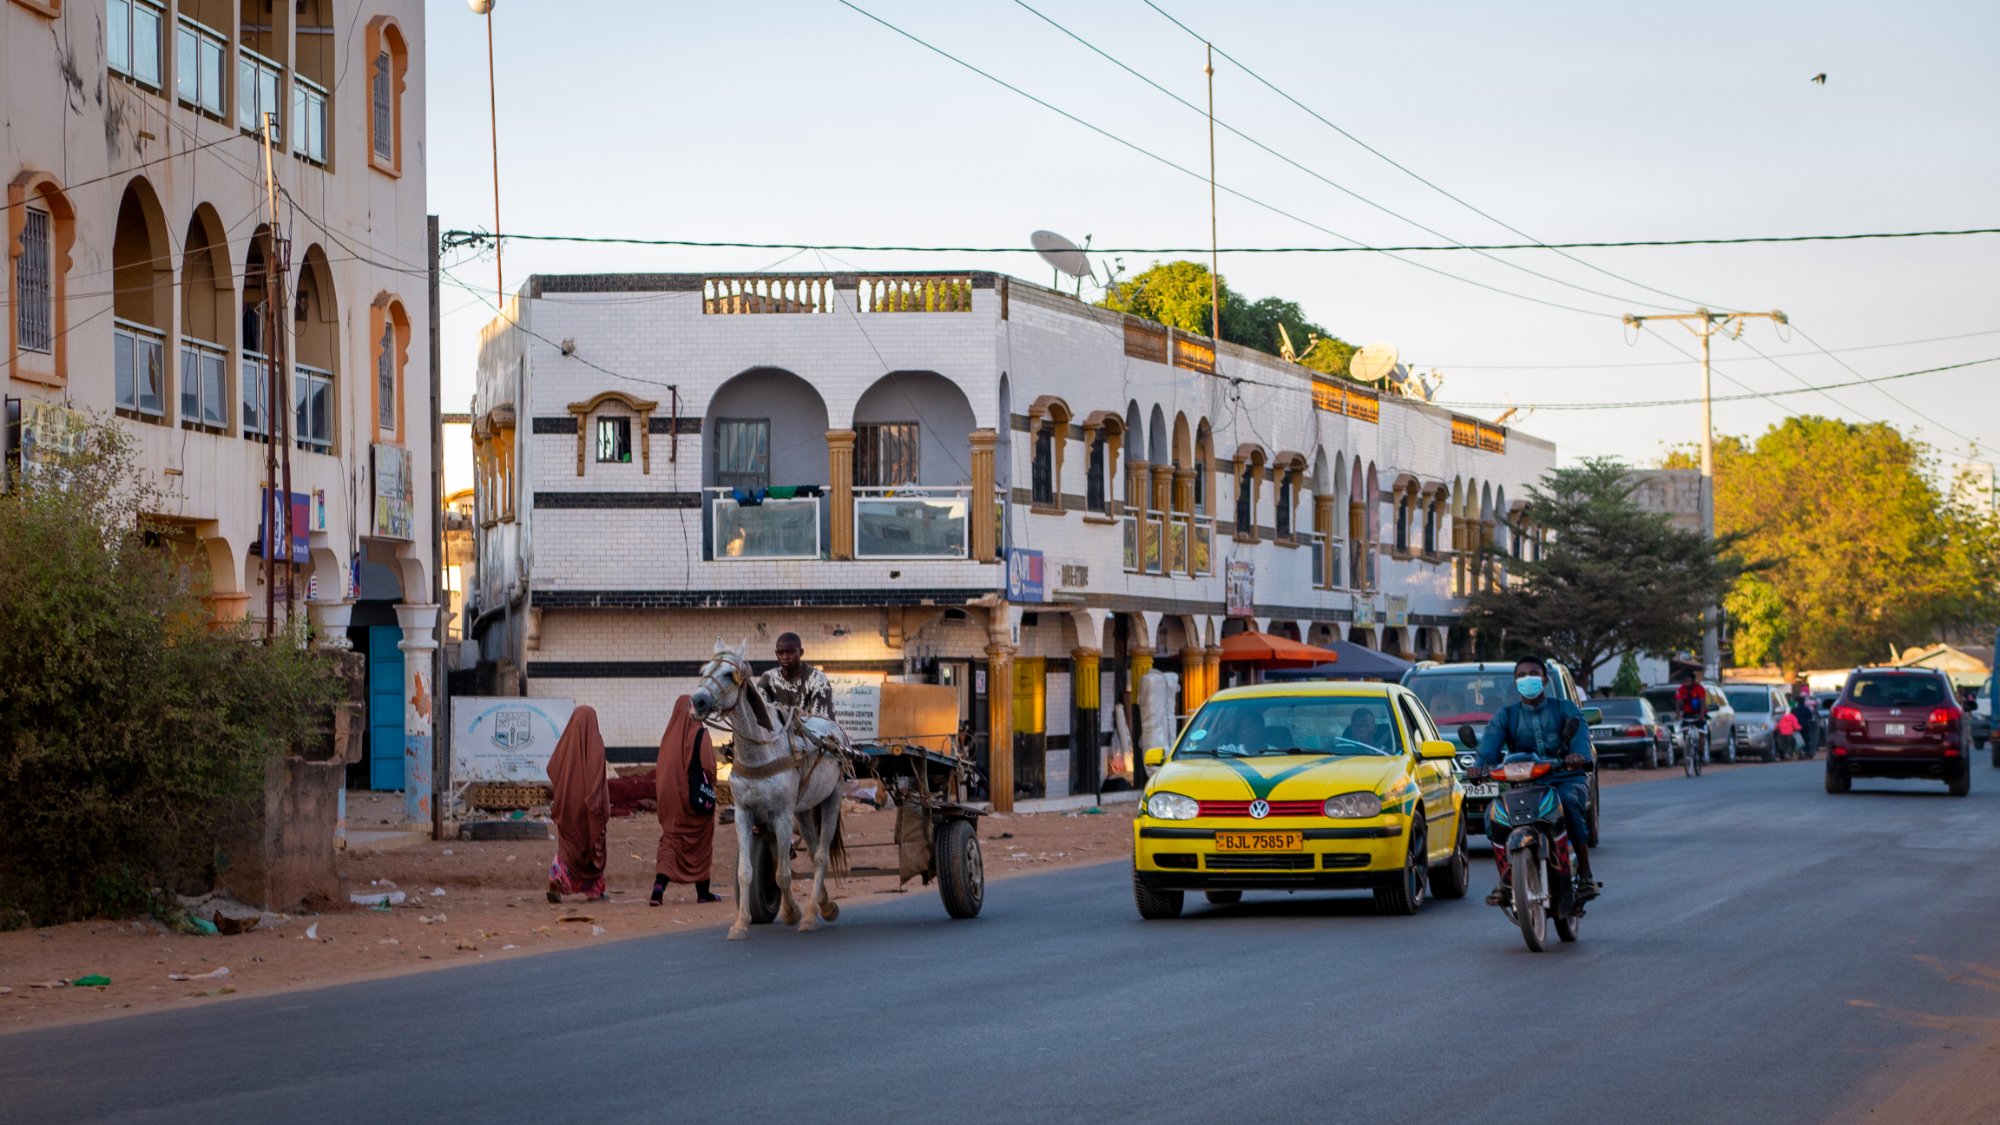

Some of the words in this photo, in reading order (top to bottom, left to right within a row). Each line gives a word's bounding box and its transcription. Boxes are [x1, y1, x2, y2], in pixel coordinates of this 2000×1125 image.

[1226, 835, 1250, 849] BJL
[1253, 835, 1284, 849] 7585
[1286, 835, 1294, 848] P
